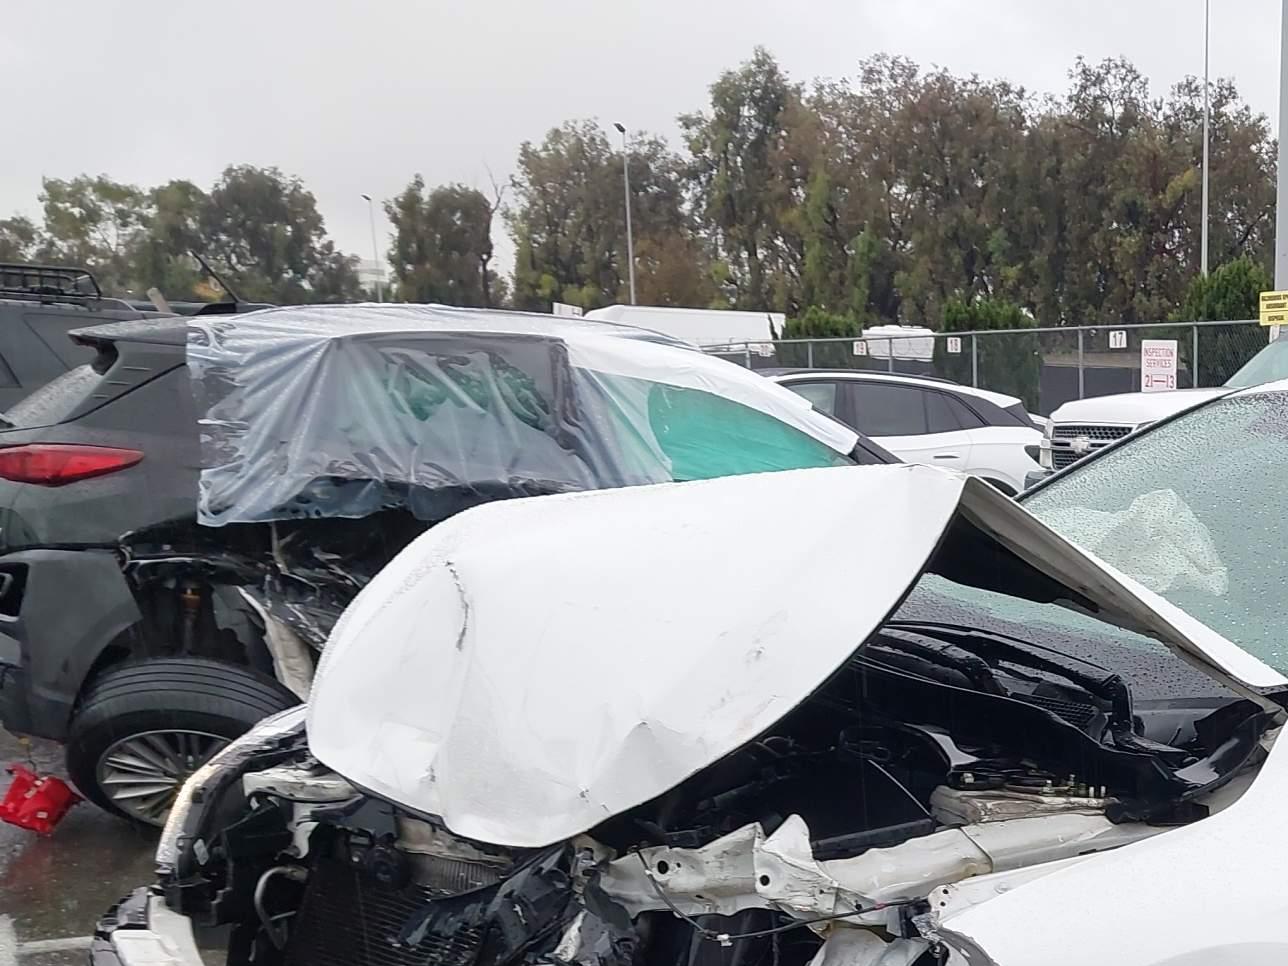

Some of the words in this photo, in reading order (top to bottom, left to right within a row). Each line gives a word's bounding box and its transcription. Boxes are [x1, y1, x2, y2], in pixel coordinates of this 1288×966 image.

[1112, 331, 1124, 346] 17
[1143, 347, 1174, 357] INSPECTION
[1145, 358, 1172, 368] SERVICES
